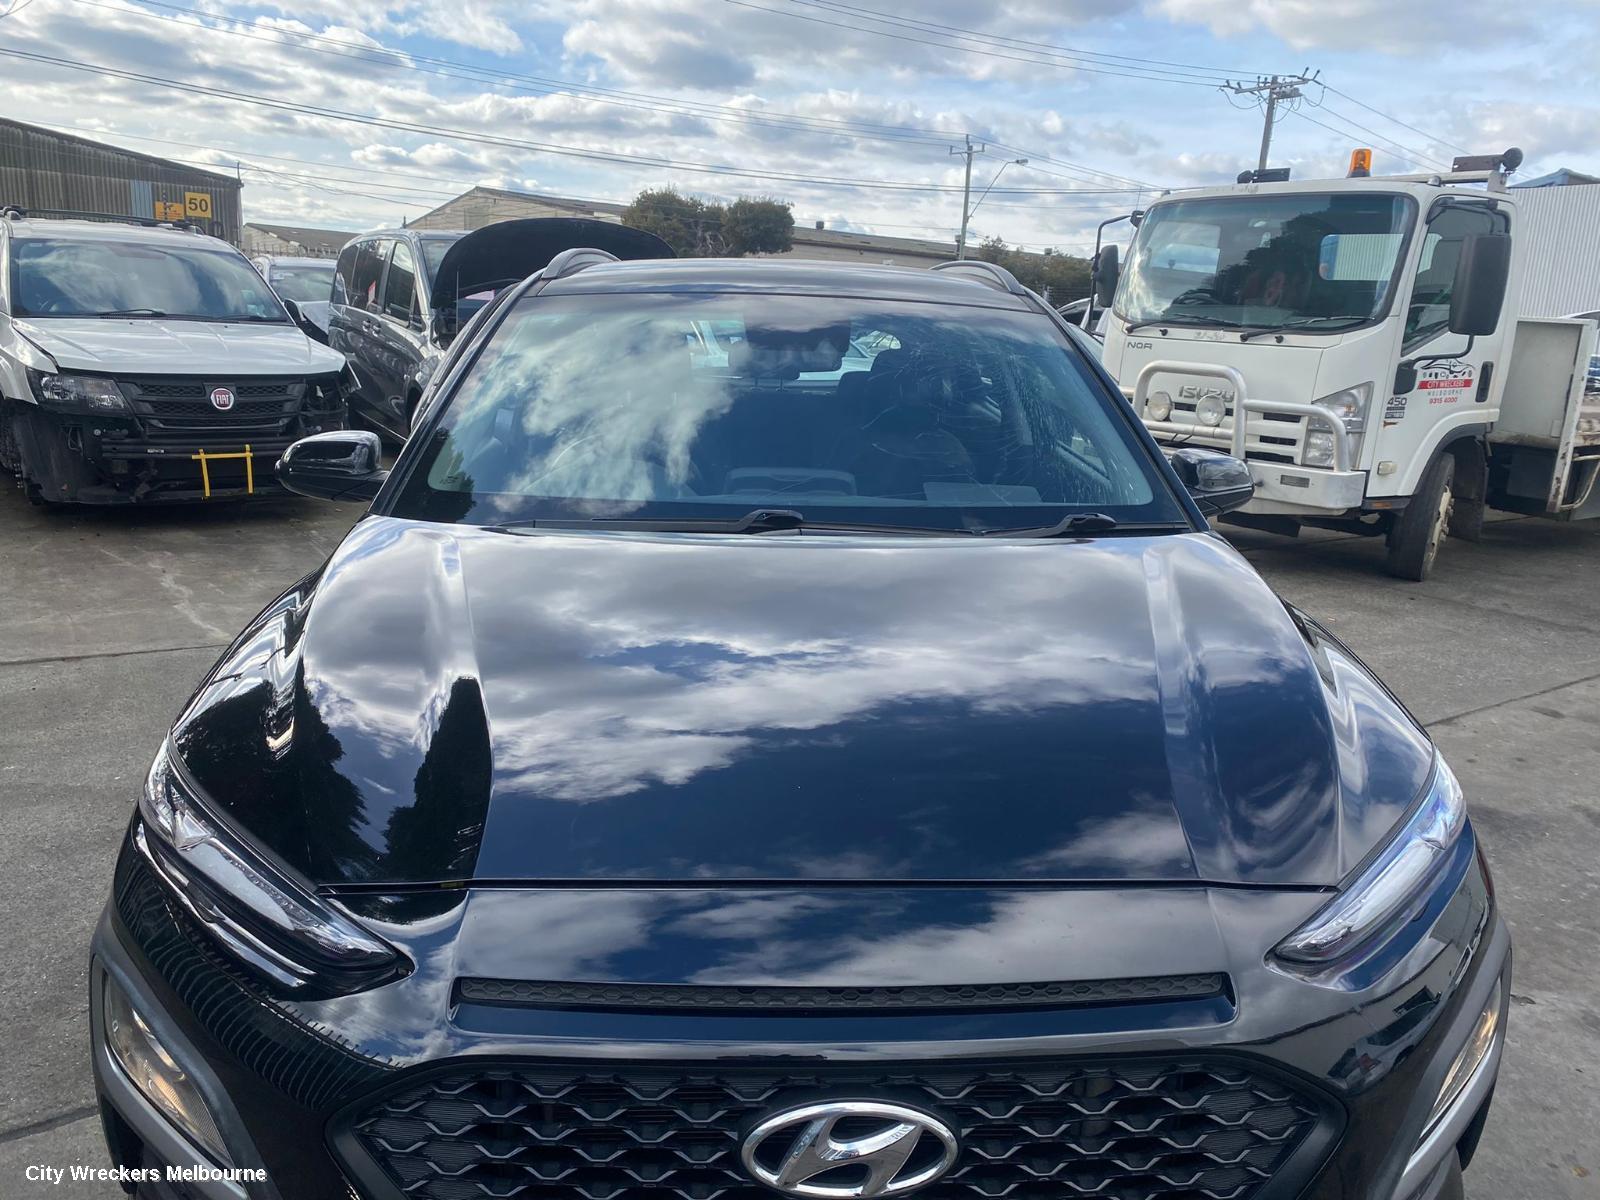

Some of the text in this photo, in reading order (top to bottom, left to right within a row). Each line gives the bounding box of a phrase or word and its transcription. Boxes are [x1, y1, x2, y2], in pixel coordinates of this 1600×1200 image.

[189, 198, 208, 212] 50
[215, 394, 230, 405] FIAT
[1178, 386, 1235, 402] ISUZU
[1387, 397, 1407, 405] 450
